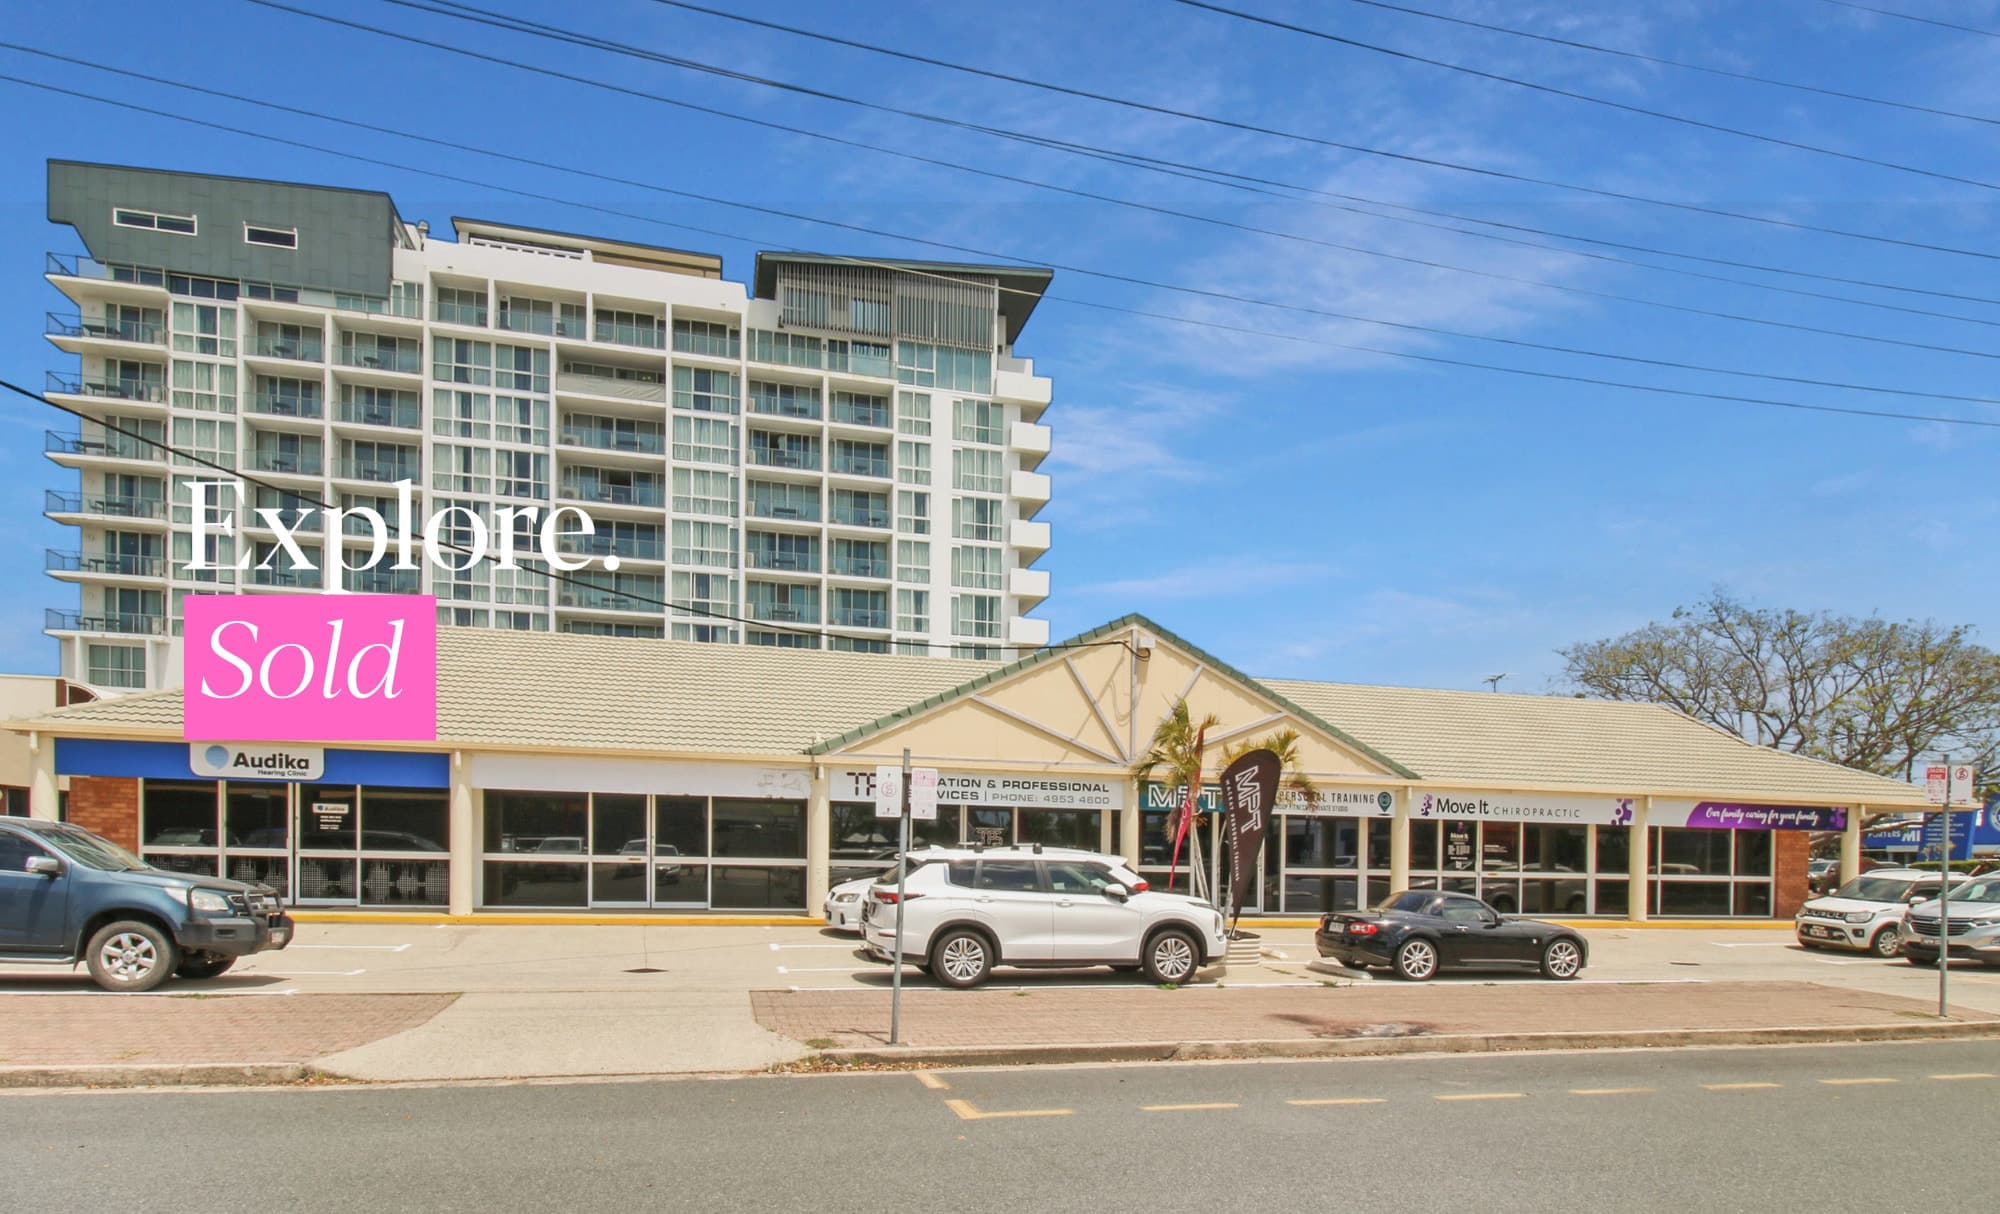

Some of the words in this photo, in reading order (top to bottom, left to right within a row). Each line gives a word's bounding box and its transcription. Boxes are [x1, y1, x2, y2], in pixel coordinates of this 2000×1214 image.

[234, 752, 310, 769] Audika
[847, 771, 877, 796] TP
[937, 777, 982, 789] ATION
[987, 780, 996, 789] &
[1002, 780, 1110, 793] PROFESSIONAL
[937, 789, 980, 800] VICES
[992, 792, 1038, 803] PHONE:
[1043, 794, 1075, 804] 4953
[1079, 795, 1110, 805] 4600
[1235, 764, 1262, 834] MPT
[1331, 792, 1375, 804] TRAINING
[1436, 798, 1476, 814] Move
[1479, 799, 1489, 814] It
[1494, 807, 1581, 818] CHIROPRACTIC
[1720, 808, 1744, 824] family
[1745, 810, 1768, 824] caring
[1767, 809, 1779, 825] for
[1795, 810, 1819, 826] family
